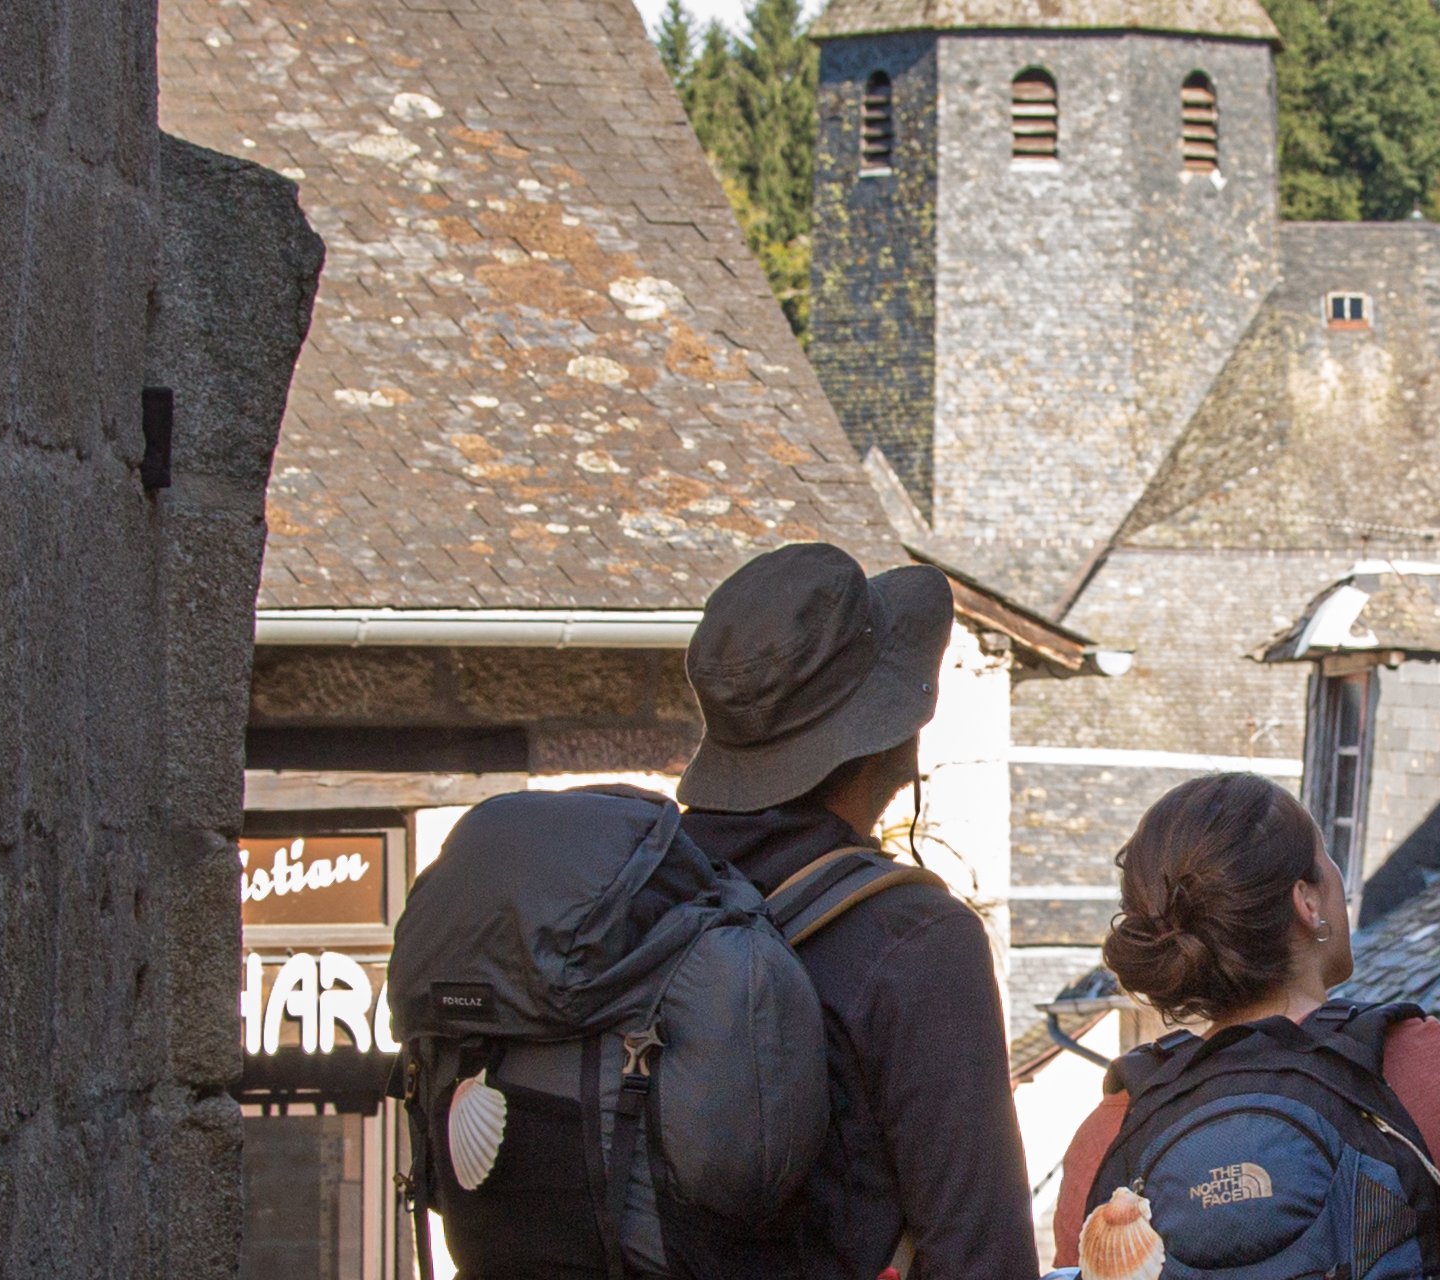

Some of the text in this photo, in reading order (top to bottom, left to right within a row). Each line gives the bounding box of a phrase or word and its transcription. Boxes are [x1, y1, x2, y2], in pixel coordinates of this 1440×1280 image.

[1208, 1164, 1242, 1181] THE
[1189, 1177, 1242, 1200] NORTH
[1201, 1188, 1244, 1209] FACE
